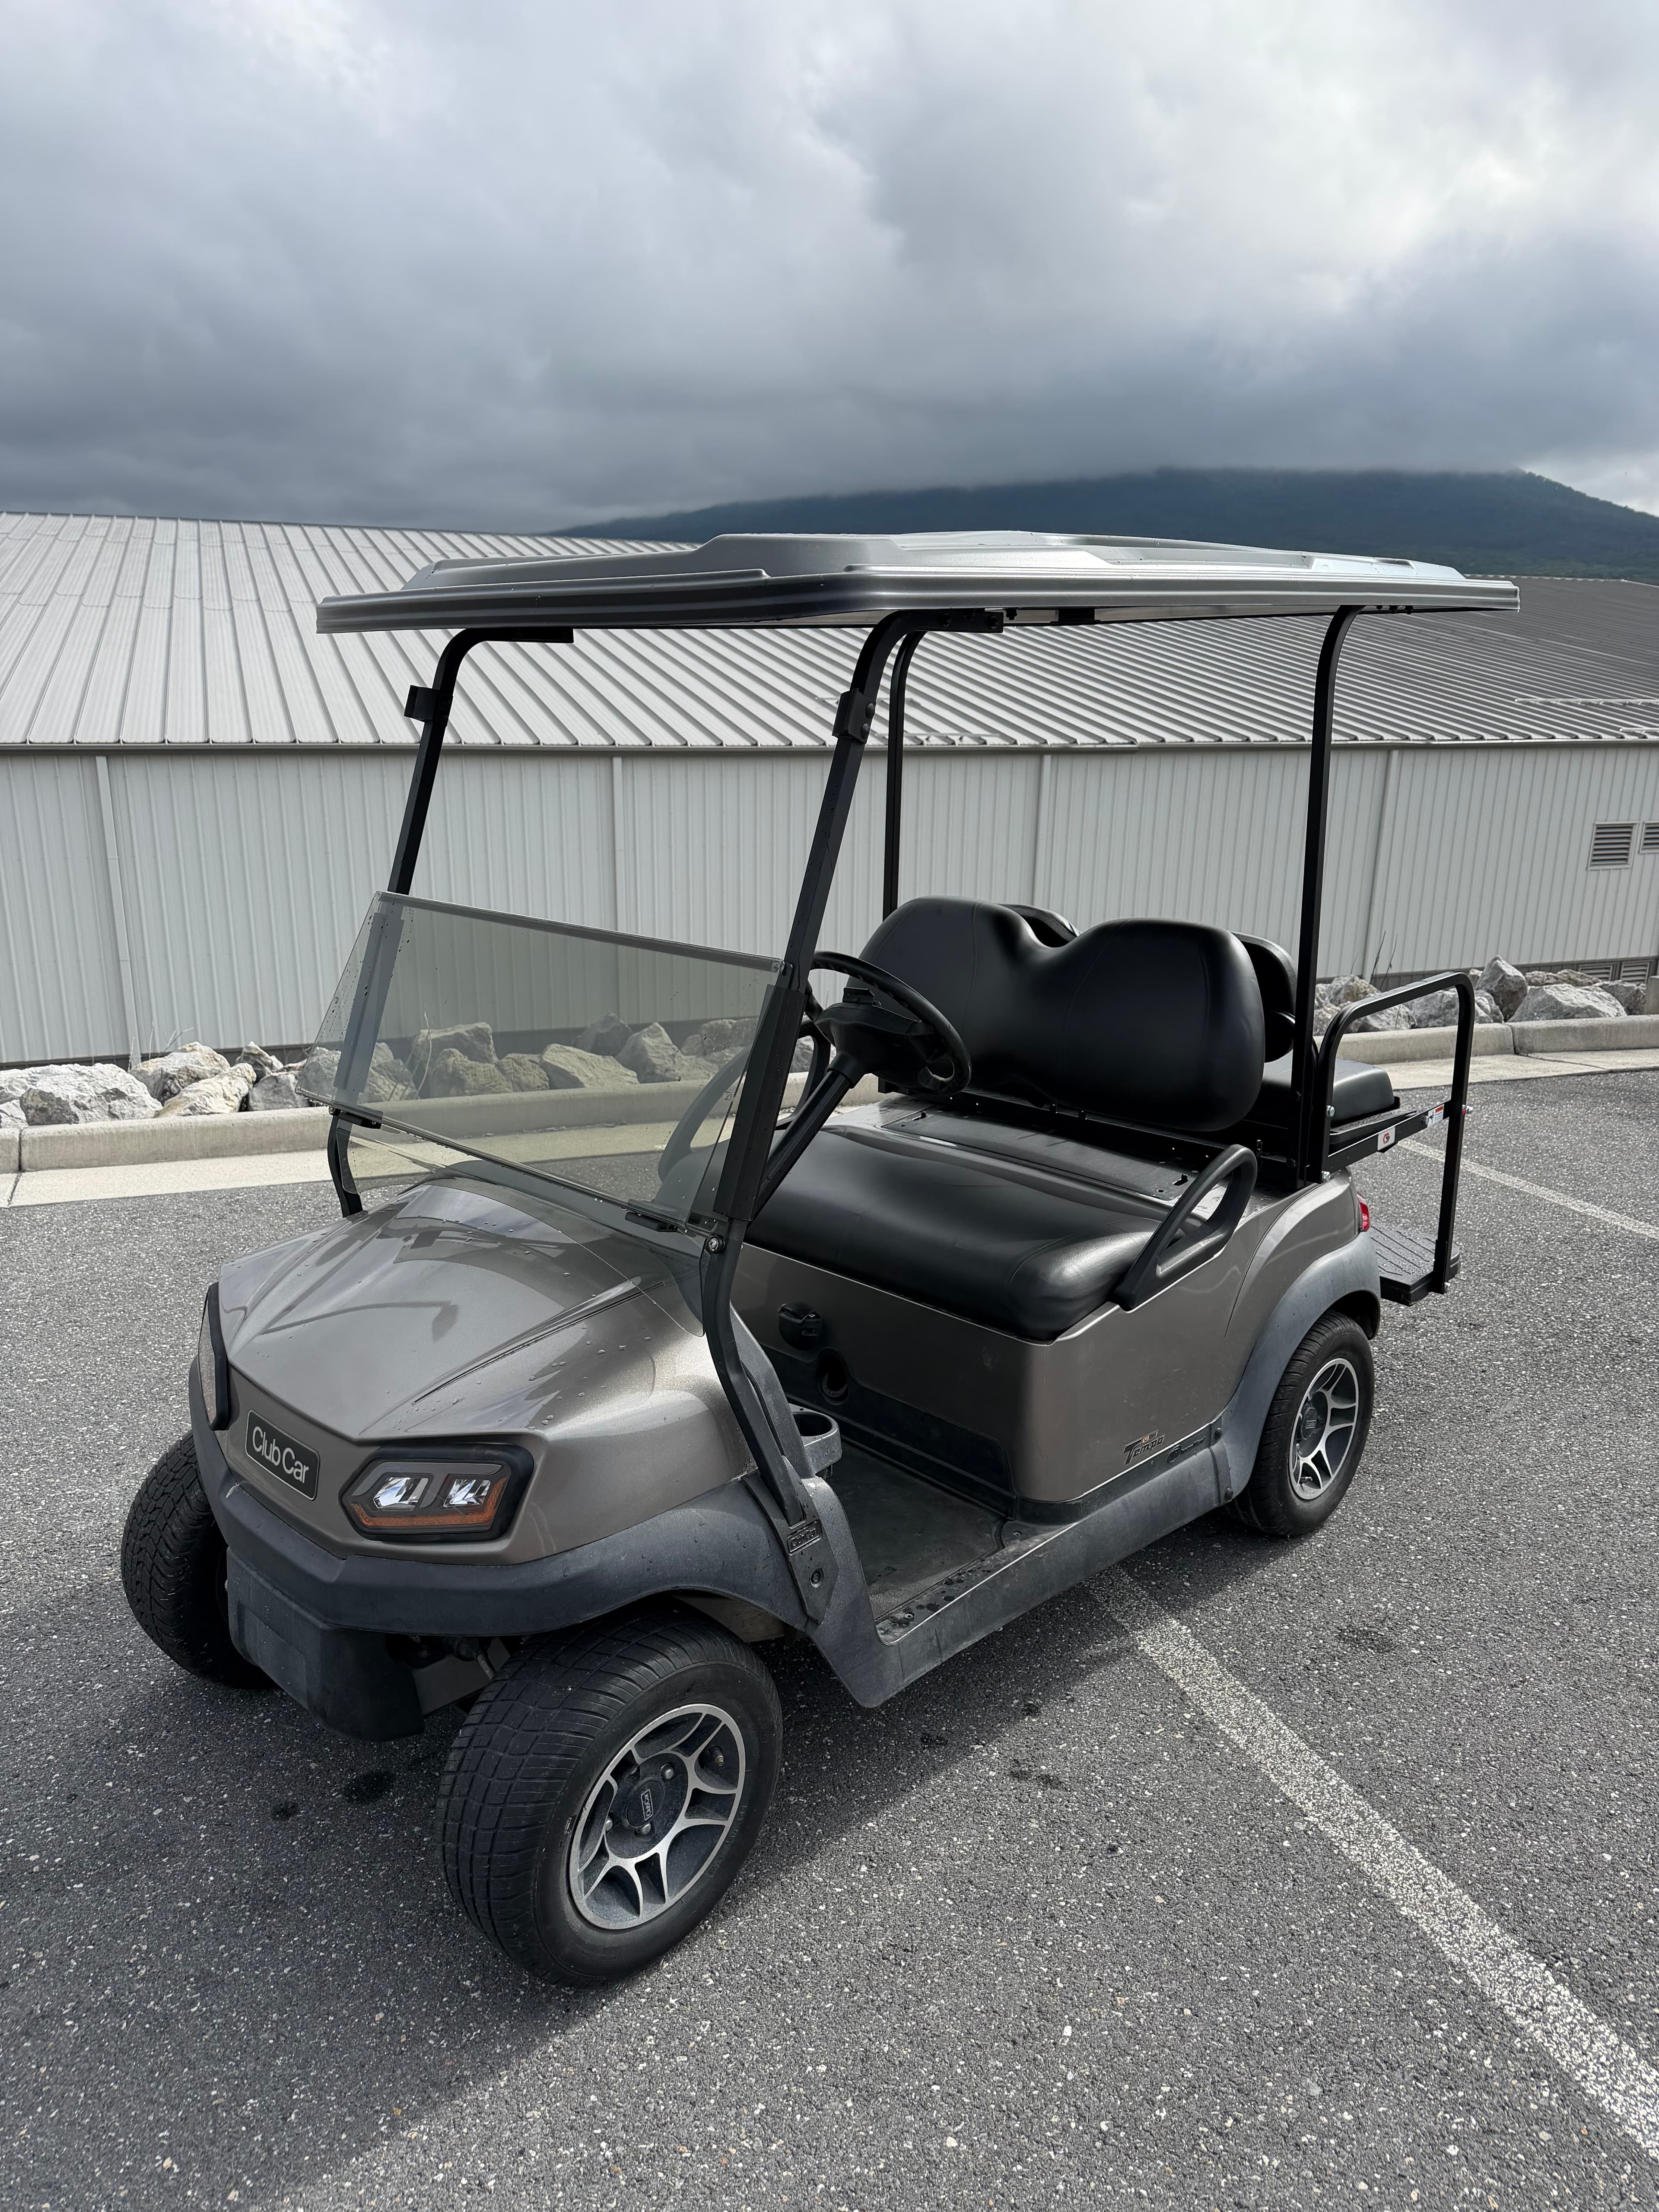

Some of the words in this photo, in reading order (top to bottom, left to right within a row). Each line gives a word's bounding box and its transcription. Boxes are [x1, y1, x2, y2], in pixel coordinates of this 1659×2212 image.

[252, 1426, 281, 1466] Club
[282, 1447, 309, 1484] Car
[1123, 1434, 1165, 1465] Tempo
[791, 1533, 804, 1546] Club
[805, 1528, 816, 1539] Car
